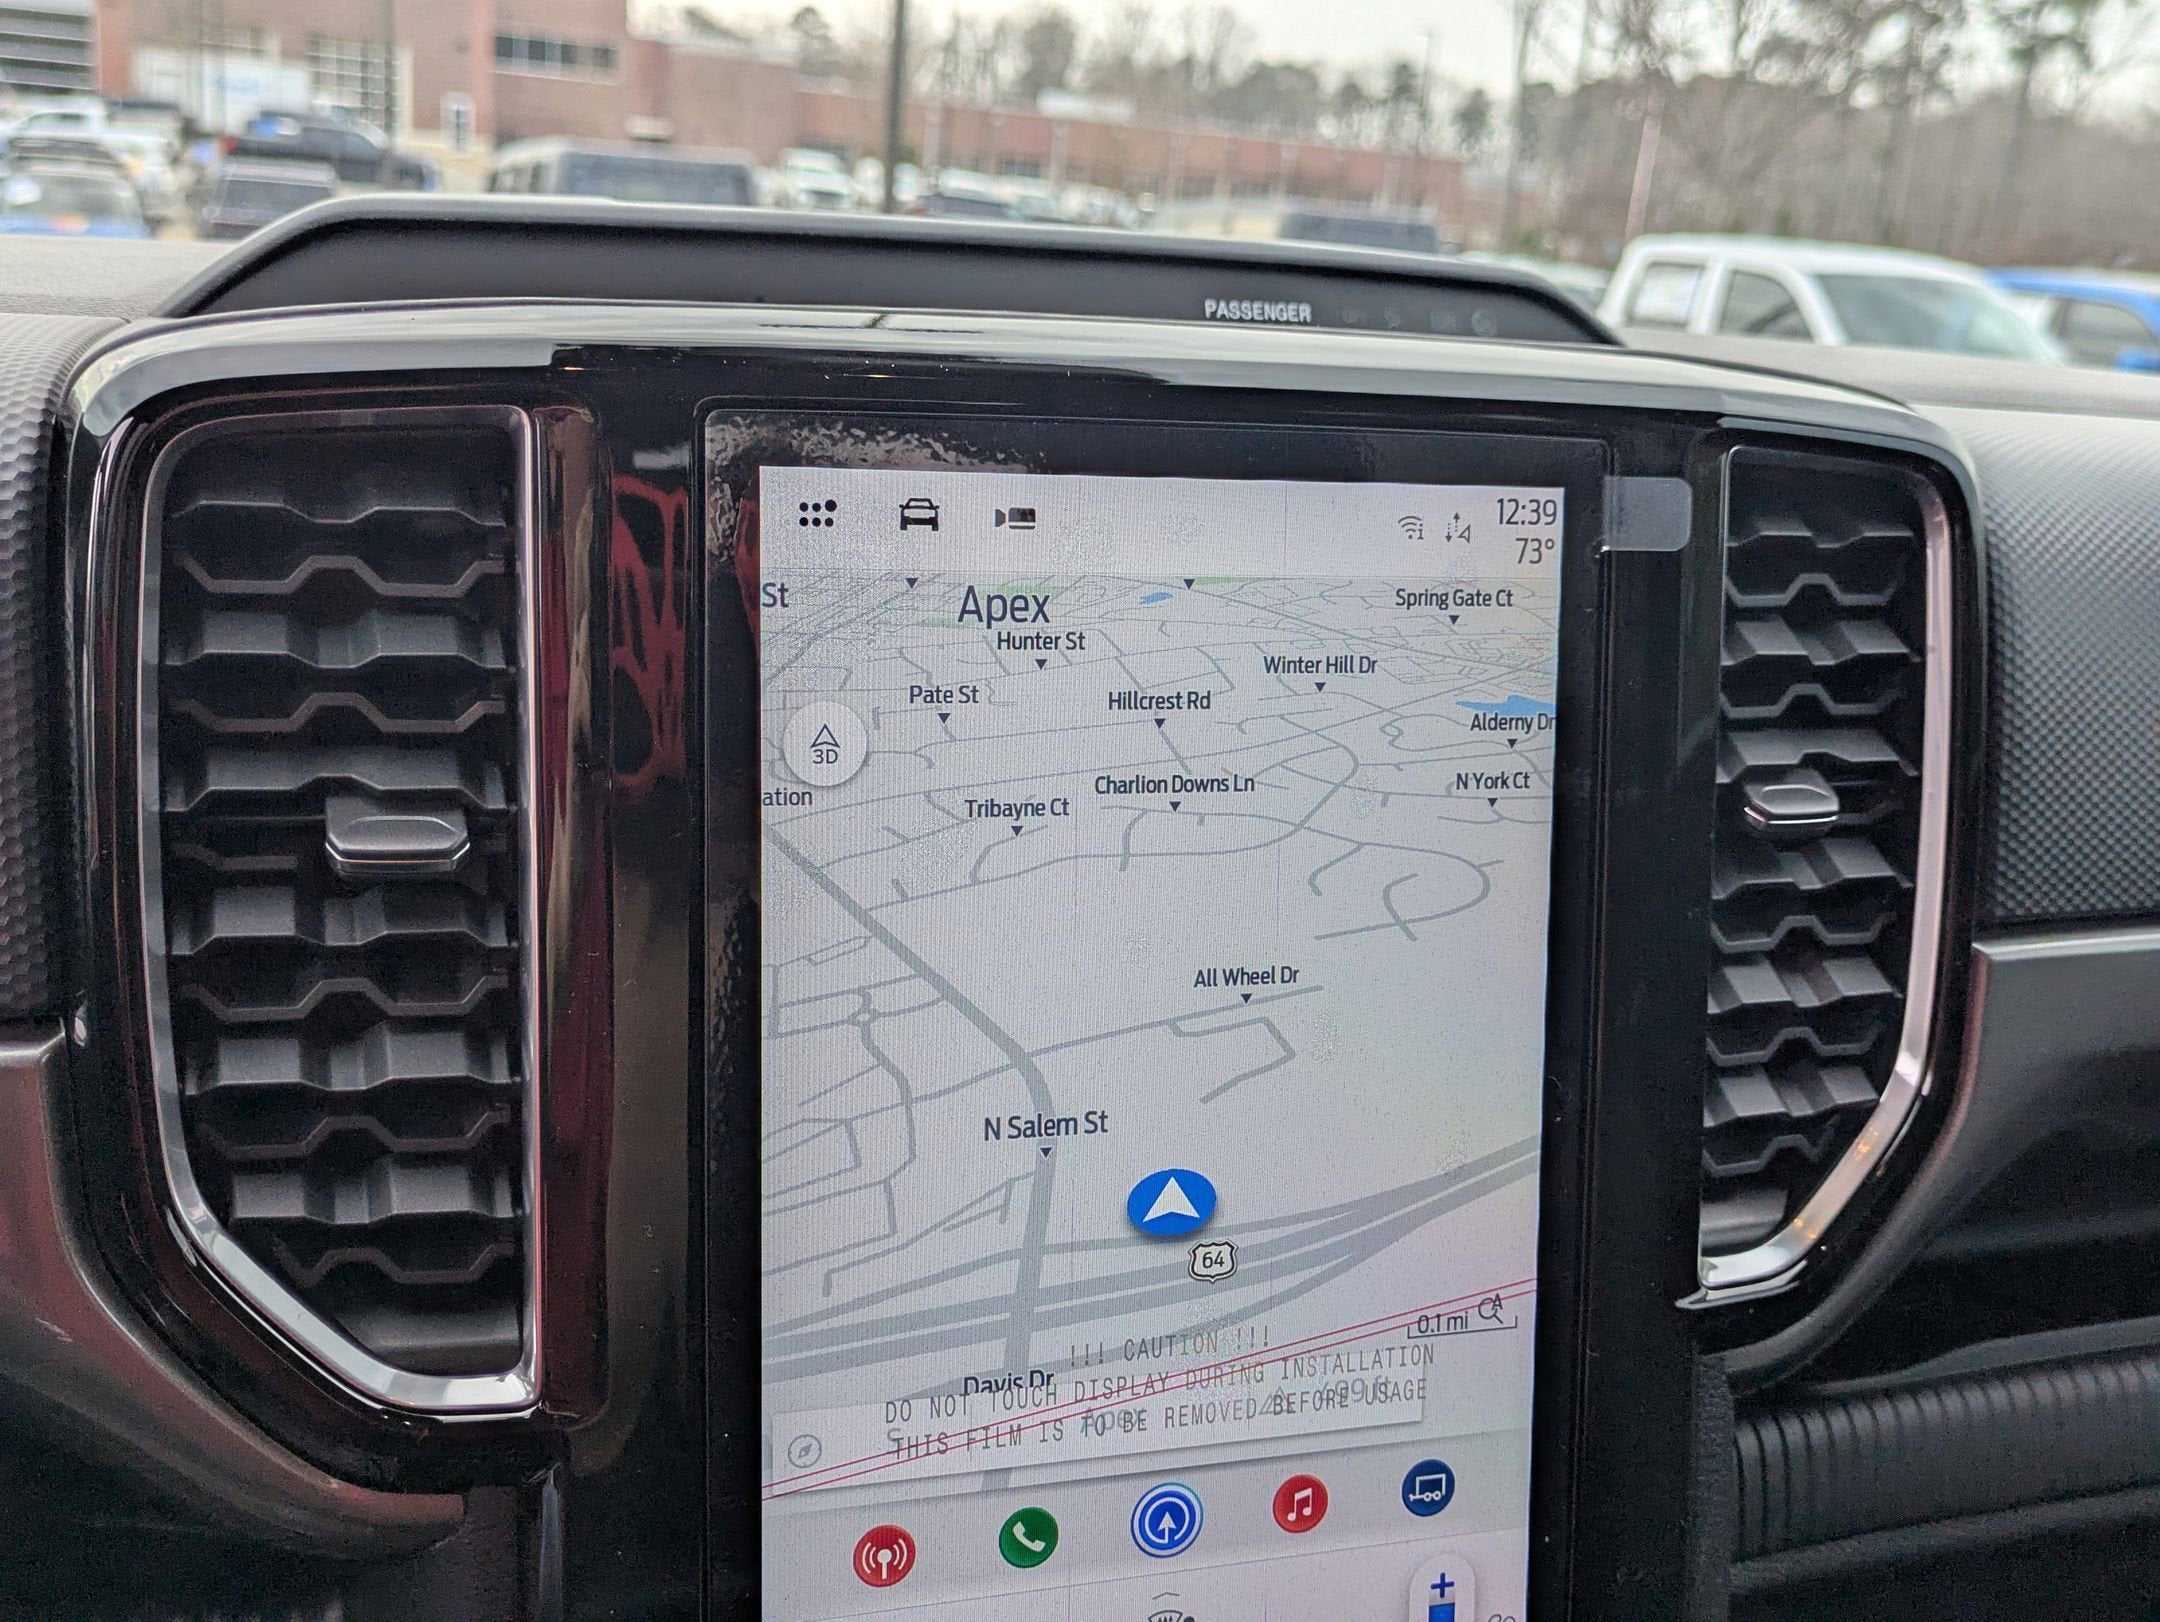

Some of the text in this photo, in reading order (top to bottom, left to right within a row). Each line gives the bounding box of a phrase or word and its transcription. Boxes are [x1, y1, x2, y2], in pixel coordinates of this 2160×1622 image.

[1204, 299, 1312, 322] PASSENGER
[1497, 498, 1557, 526] 12:39
[1515, 538, 1555, 564] 73°
[762, 582, 789, 608] St
[1395, 589, 1514, 611] Spring Gate Ct
[957, 585, 1050, 629] Apex
[997, 631, 1086, 651] Hunter St
[1263, 655, 1378, 674] Winter Hill Dr
[909, 686, 979, 704] Pate St
[1107, 690, 1211, 711] Hillcrest Rd
[1470, 713, 1554, 734] Alderny Dr
[812, 750, 838, 765] 3D
[1095, 774, 1256, 795] Charlion Downs Ln
[1456, 772, 1530, 790] N York Ct
[762, 788, 813, 807] ation
[965, 798, 1070, 821] Tribayne Ct
[1194, 966, 1300, 988] All Wheel Dr
[984, 1111, 1109, 1141] N Salem St
[1202, 1250, 1225, 1269] 64
[1418, 1311, 1468, 1333] 0.1 mi
[1124, 1330, 1218, 1361] CAUTION
[886, 1343, 1434, 1424] DO NOT TOUCH DISPLAY DURING INSTALLATION
[964, 1369, 1054, 1394] Davis Dr
[893, 1378, 1427, 1460] THIS FILM IS TO BE REMOVED BEFORE USAGE
